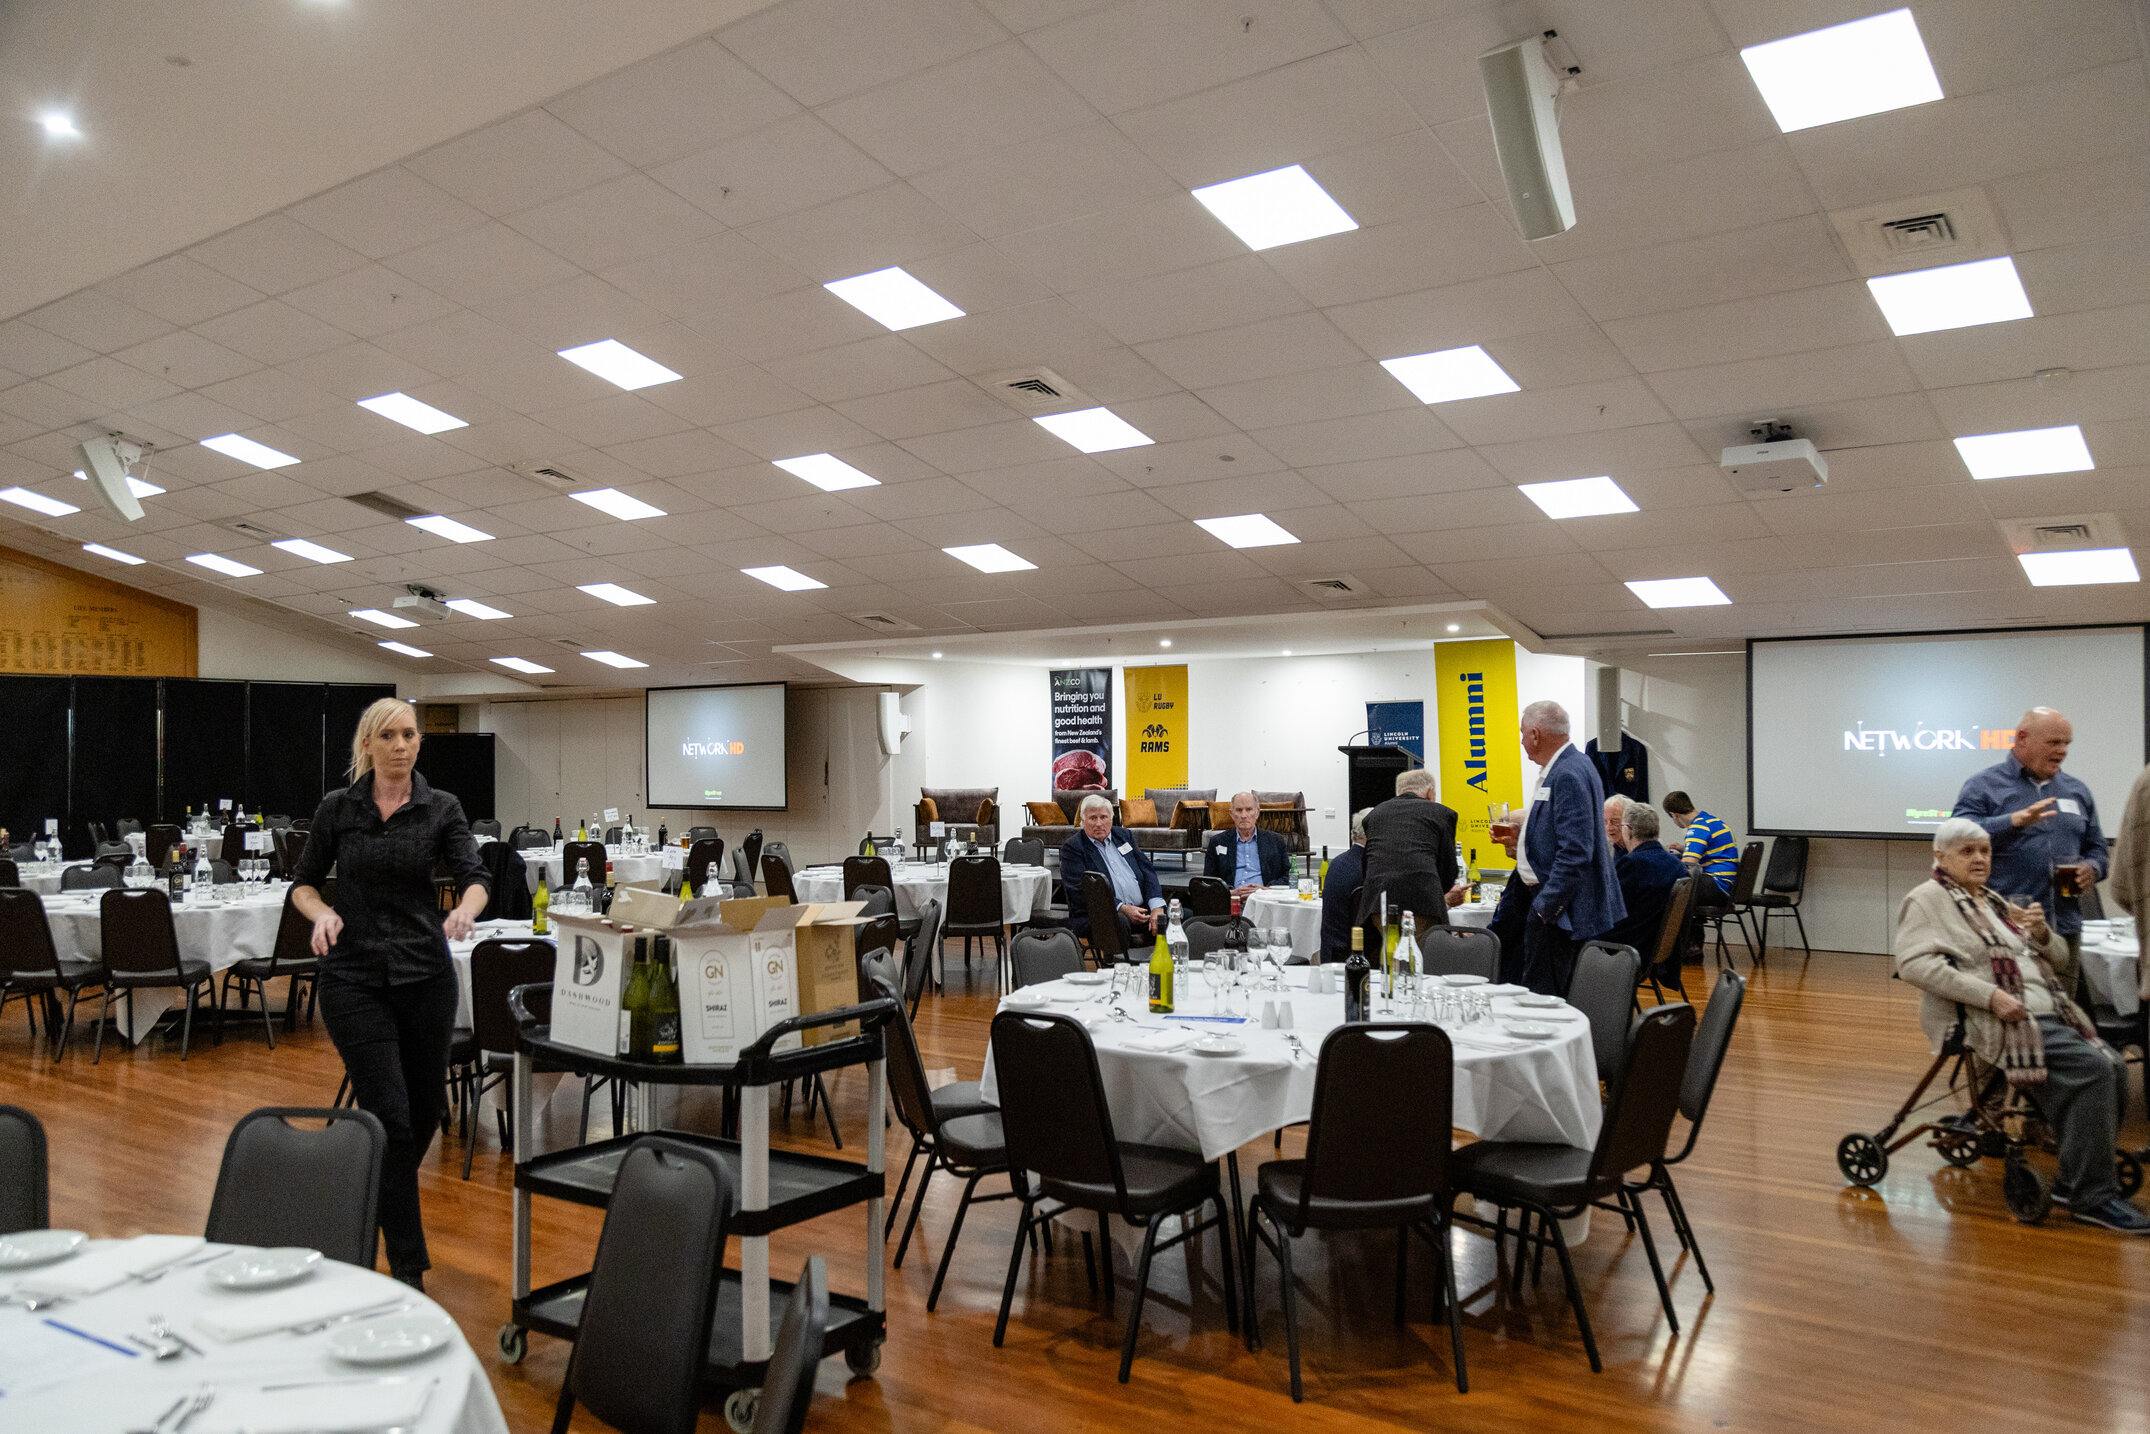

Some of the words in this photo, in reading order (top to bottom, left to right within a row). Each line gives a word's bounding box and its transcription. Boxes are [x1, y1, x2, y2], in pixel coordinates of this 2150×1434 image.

[1054, 678, 1081, 687] ANZCO
[1054, 692, 1089, 703] Bringing
[1089, 692, 1105, 702] you
[1153, 693, 1163, 701] LU
[1054, 704, 1089, 714] nutrition
[1090, 703, 1106, 712] and
[1153, 702, 1175, 710] RUGBY
[1054, 716, 1077, 728] good
[1077, 715, 1103, 725] health
[1460, 672, 1488, 793] Alumni
[1844, 725, 1979, 753] NETWORK
[682, 740, 729, 757] NETWORK
[729, 741, 745, 755] HD
[1140, 741, 1170, 753] RAMS
[705, 965, 724, 979] GN
[767, 960, 784, 975] GN
[561, 988, 611, 1007] DASHWOOD
[768, 998, 788, 1008] SHIRAZ
[705, 1004, 728, 1013] SHIRAZ
